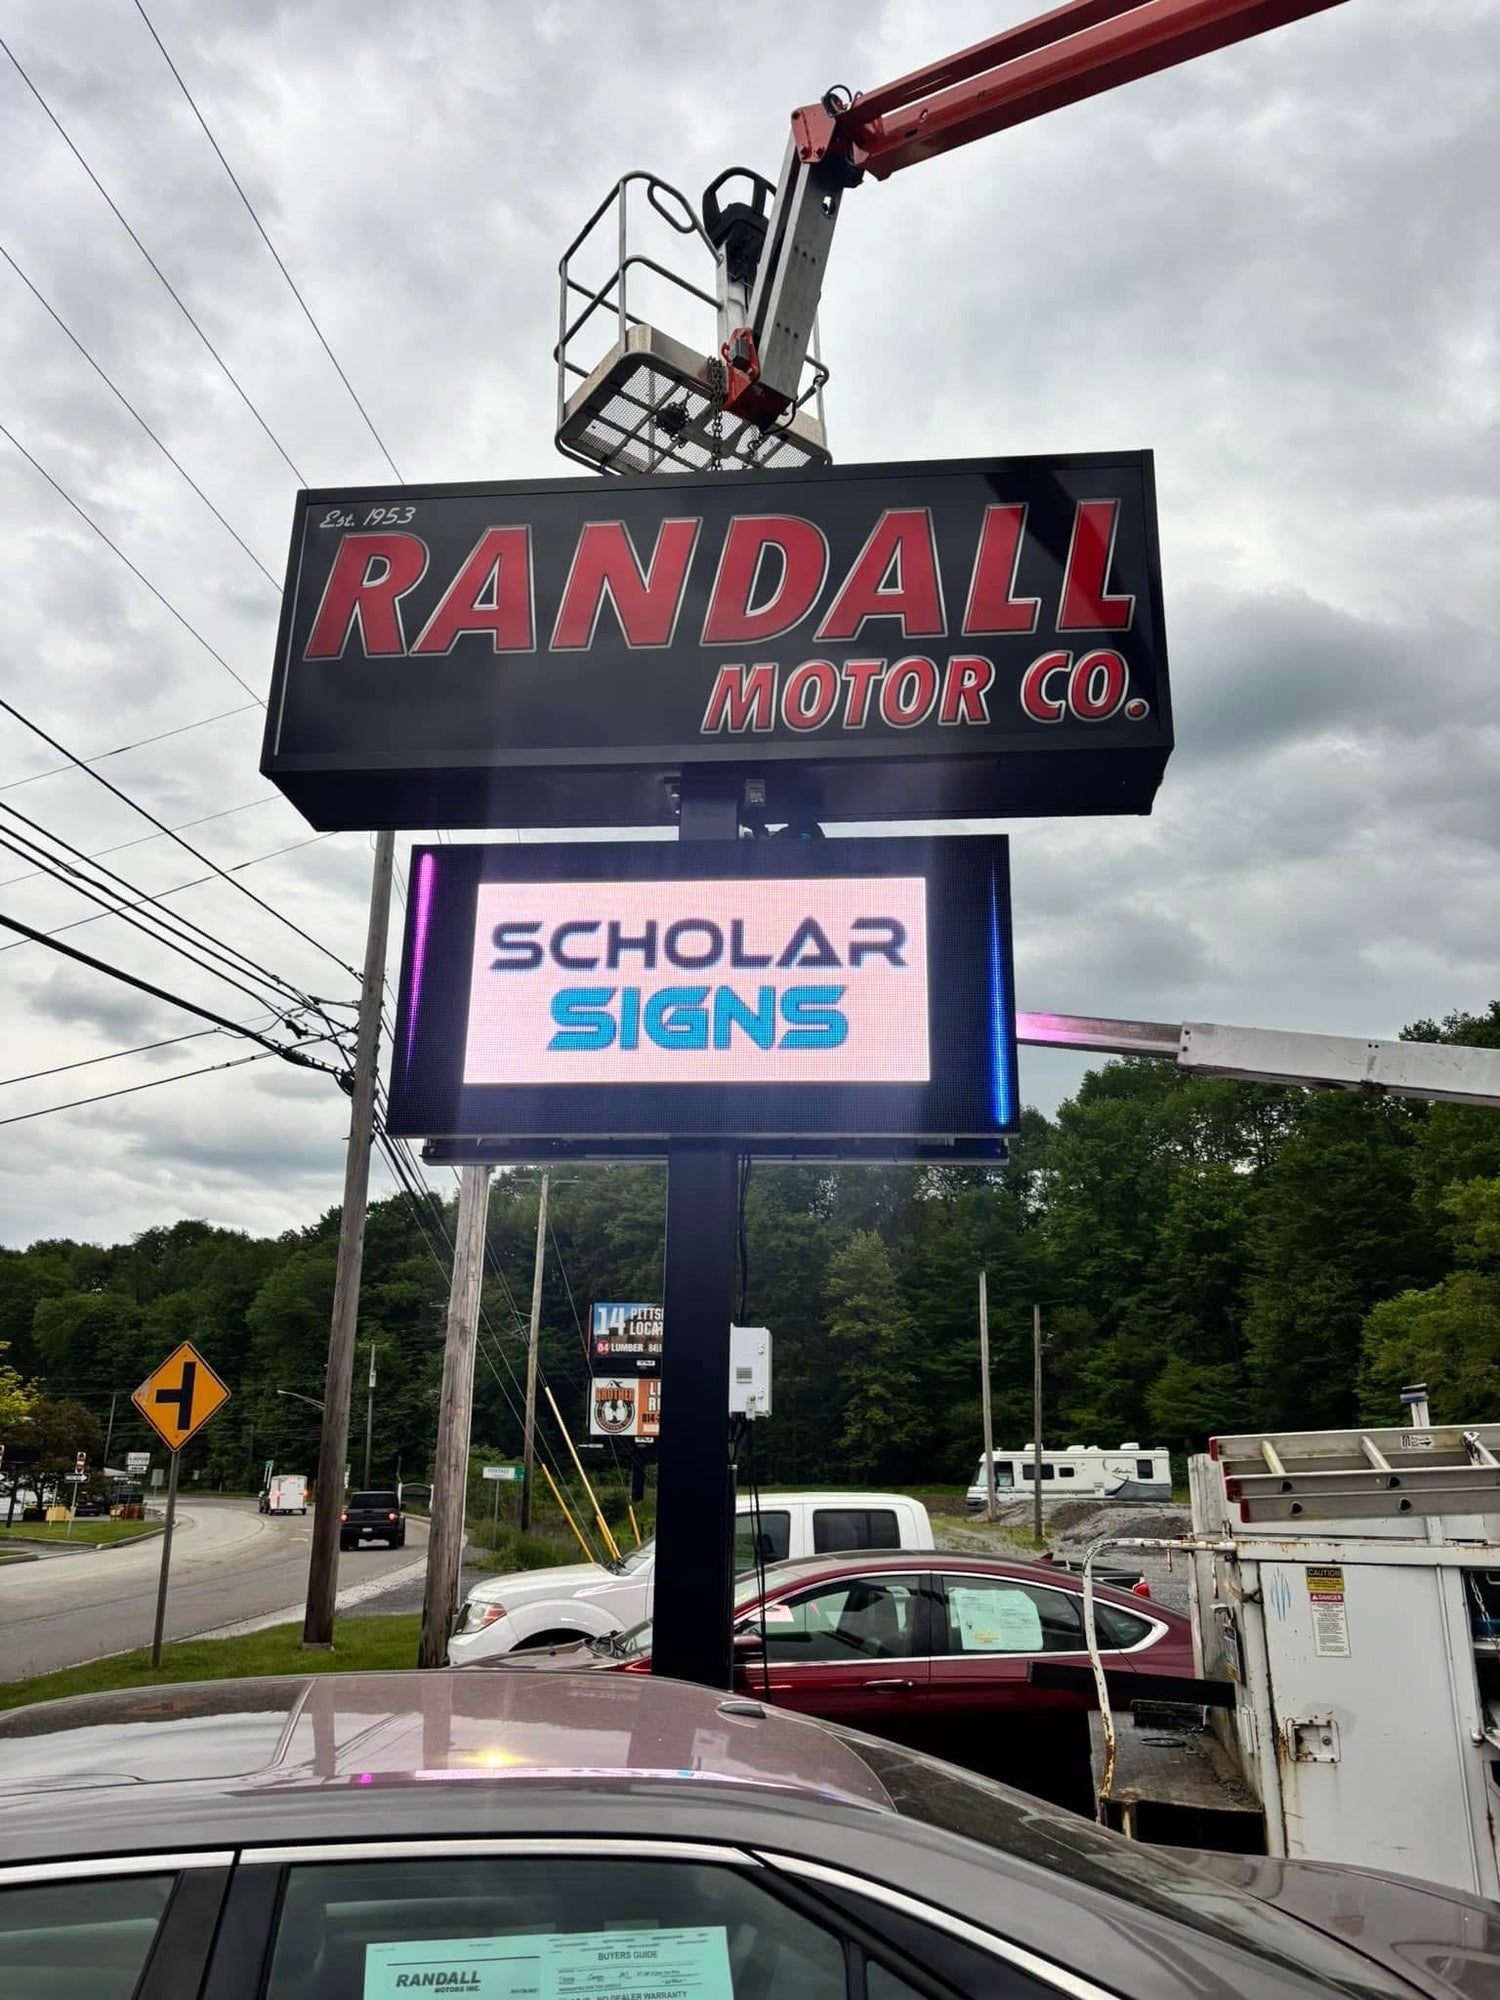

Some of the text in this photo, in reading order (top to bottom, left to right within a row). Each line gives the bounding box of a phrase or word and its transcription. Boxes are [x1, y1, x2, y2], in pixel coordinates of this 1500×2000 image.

[319, 506, 416, 528] Est. 1953
[303, 498, 1136, 661] RANDALL
[700, 649, 1152, 735] MOTOR CO.
[490, 916, 910, 972] SCHOLAR
[547, 985, 850, 1051] SIGNS
[597, 1307, 626, 1335] 14
[611, 1343, 643, 1353] LUMBER
[1308, 1569, 1341, 1577] CAUTION
[597, 1950, 658, 1961] BUYERS GUIDE
[395, 1971, 481, 1987] RANDALL
[643, 1991, 687, 2000] WARRANTY
